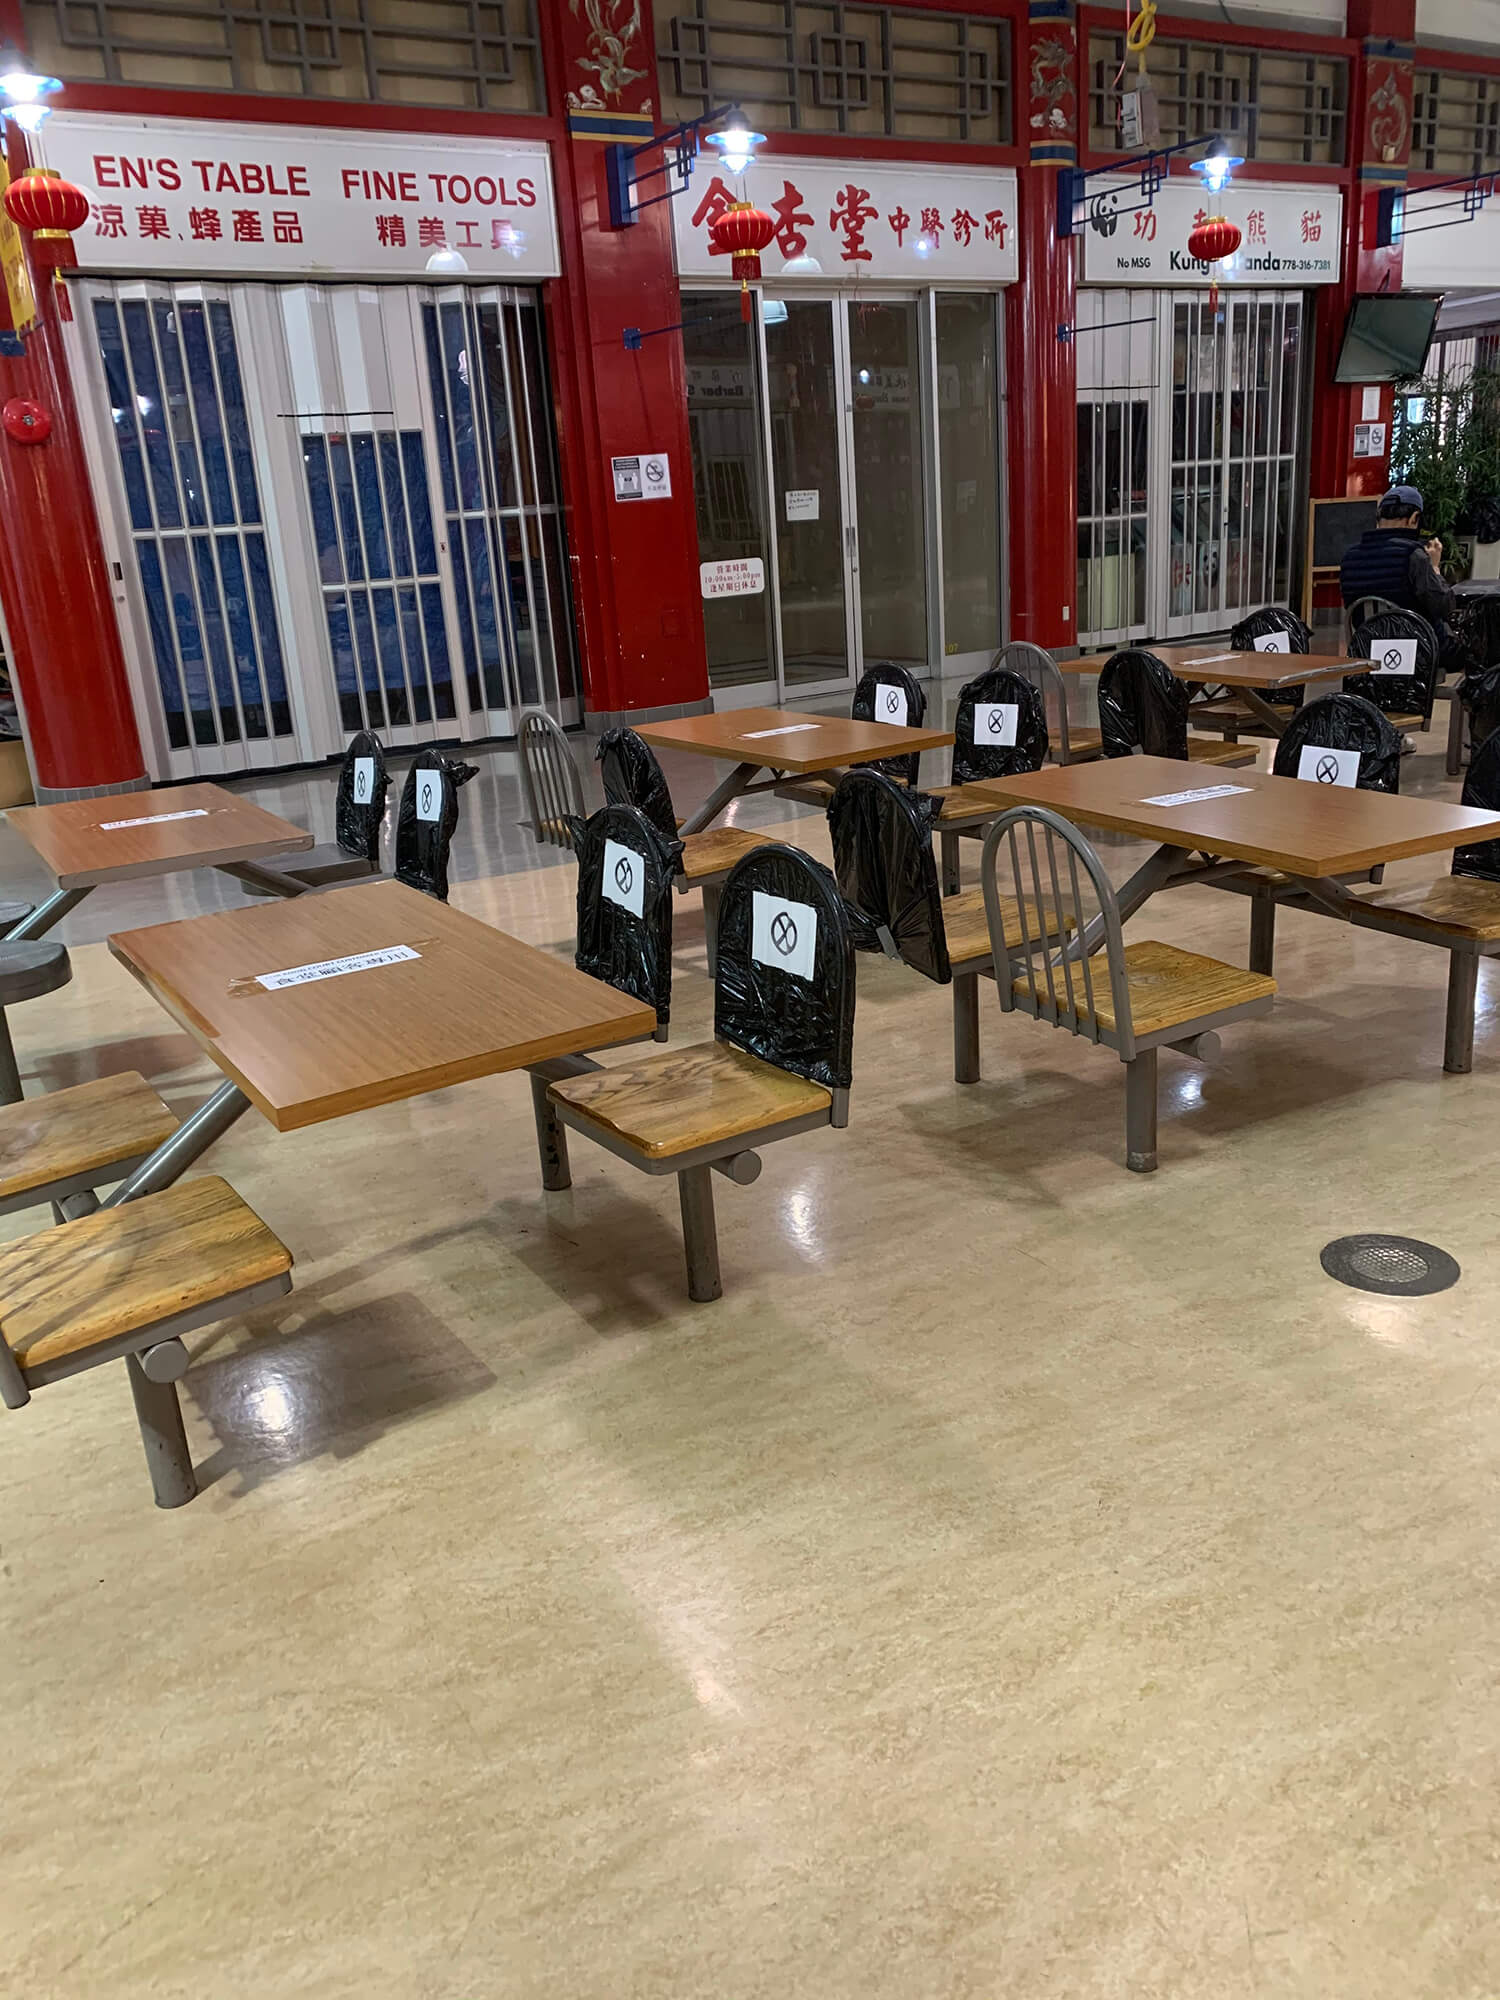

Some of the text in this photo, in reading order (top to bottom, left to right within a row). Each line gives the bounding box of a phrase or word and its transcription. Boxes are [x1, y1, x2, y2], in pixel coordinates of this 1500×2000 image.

[93, 155, 537, 207] EN'S TABLE FINE TOOLS
[1117, 257, 1151, 268] No MSG
[1170, 250, 1210, 275] Kung
